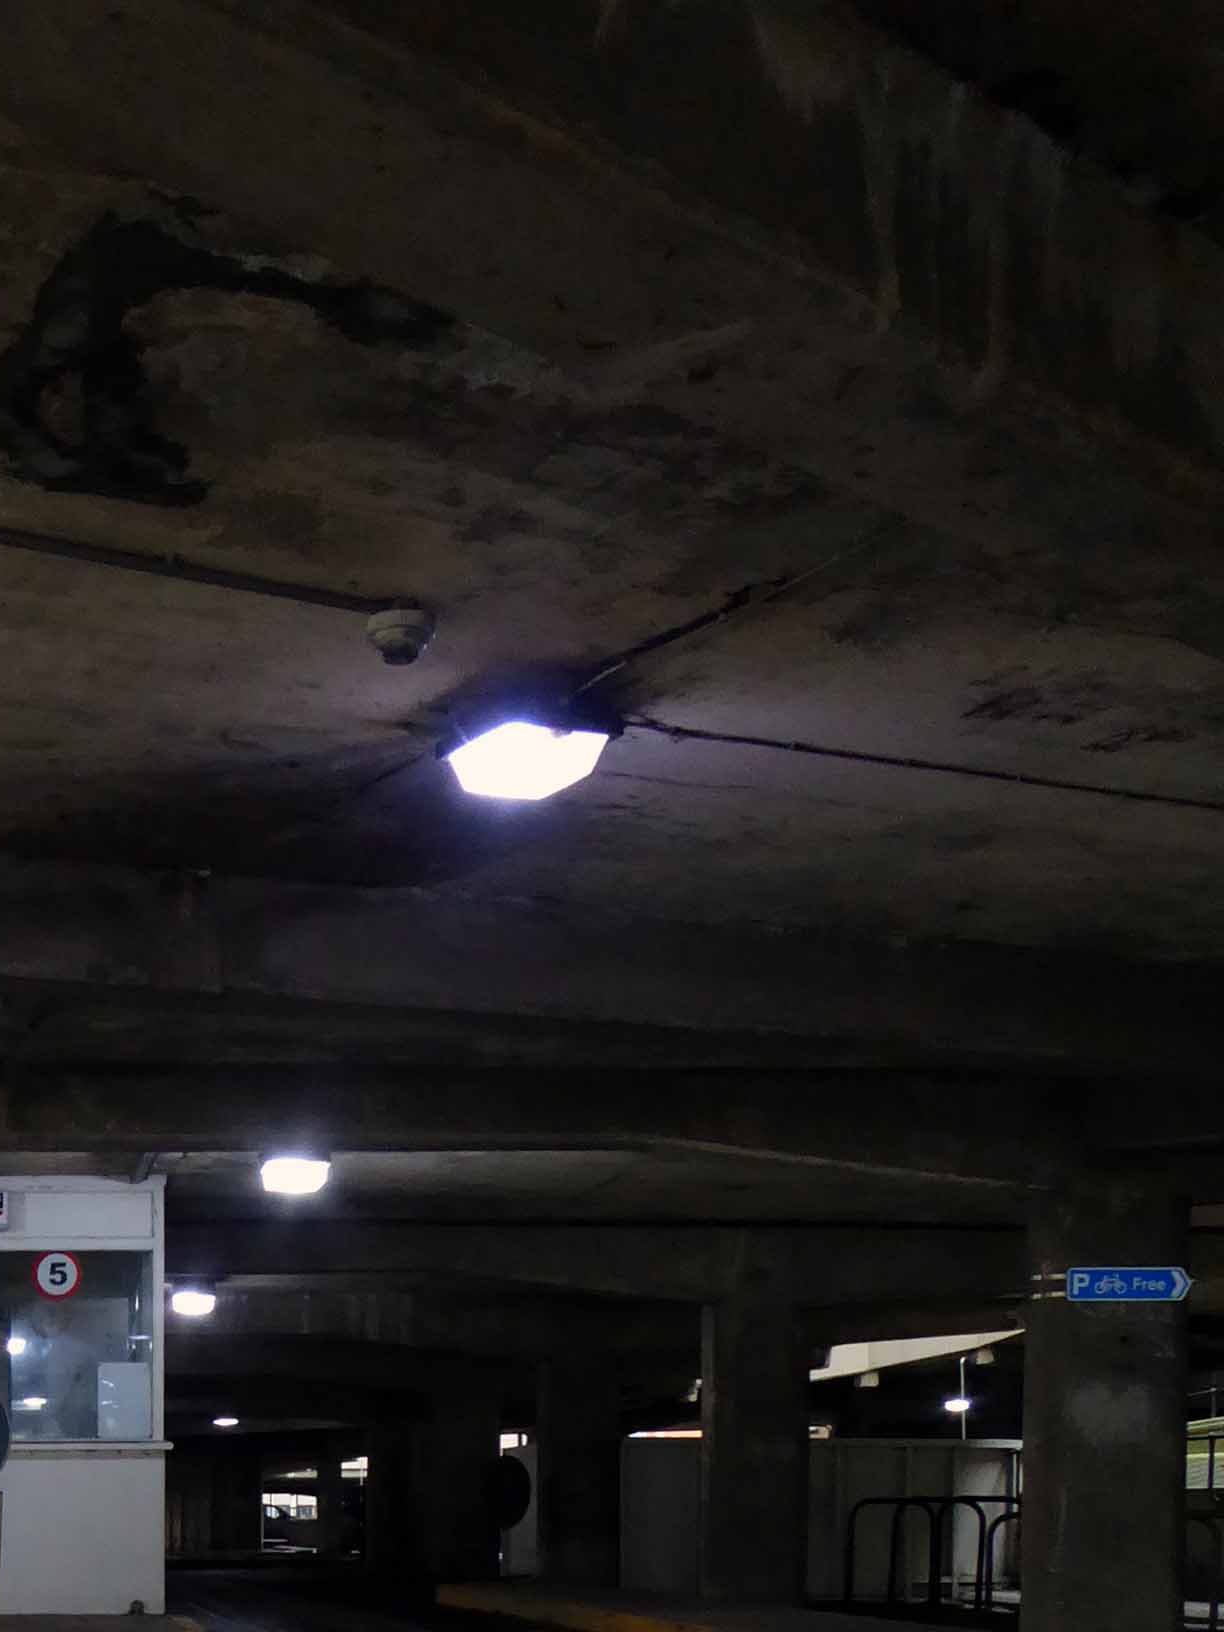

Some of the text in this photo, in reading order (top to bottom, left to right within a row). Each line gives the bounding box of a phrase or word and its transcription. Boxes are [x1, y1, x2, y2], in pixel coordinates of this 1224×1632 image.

[49, 1262, 68, 1286] 5
[1072, 1272, 1166, 1295] P Free
